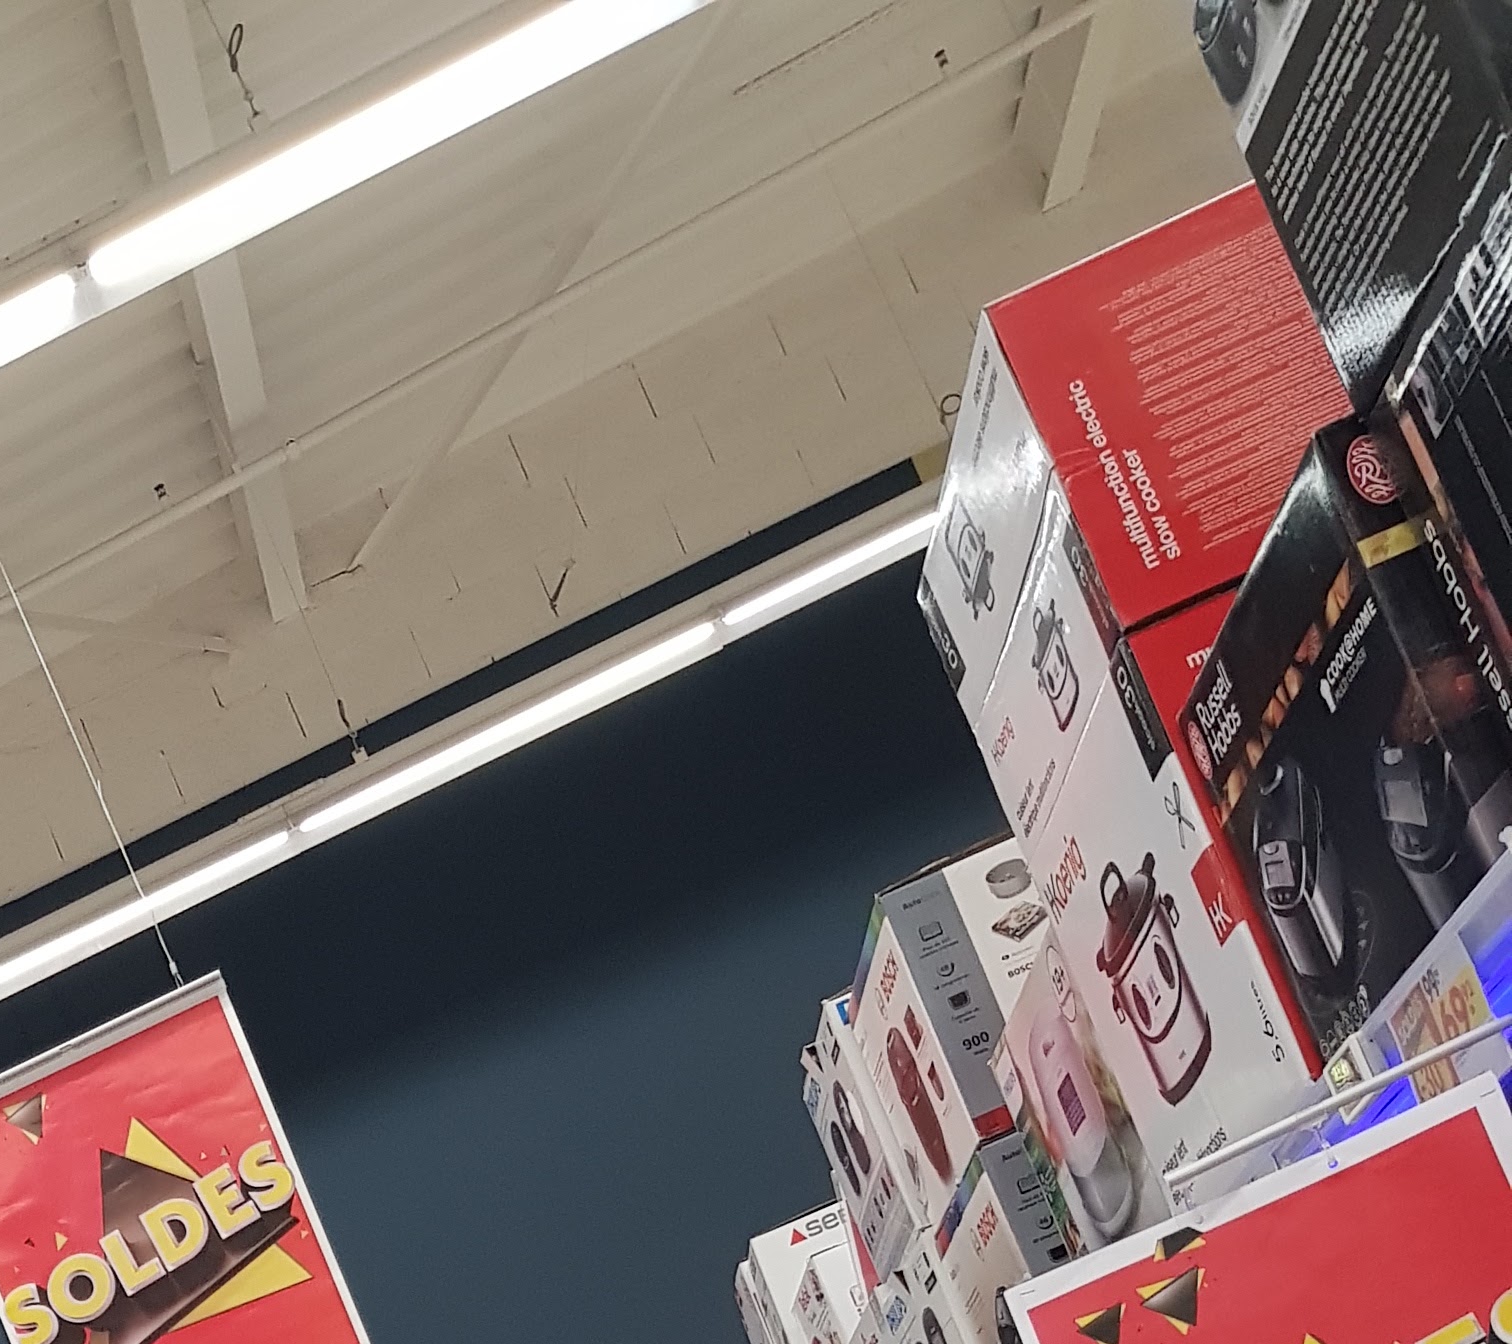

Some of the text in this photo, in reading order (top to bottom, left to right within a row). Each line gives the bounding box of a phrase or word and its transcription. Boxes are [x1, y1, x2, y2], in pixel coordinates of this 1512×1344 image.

[1069, 379, 1160, 569] multifunction electric
[1122, 448, 1180, 561] slow cooker
[1424, 518, 1481, 645] Hobbs
[1326, 596, 1378, 687] COOK@HOME
[1195, 659, 1234, 729] Russell
[1205, 702, 1243, 766] Hobbs
[962, 1031, 990, 1051] 900
